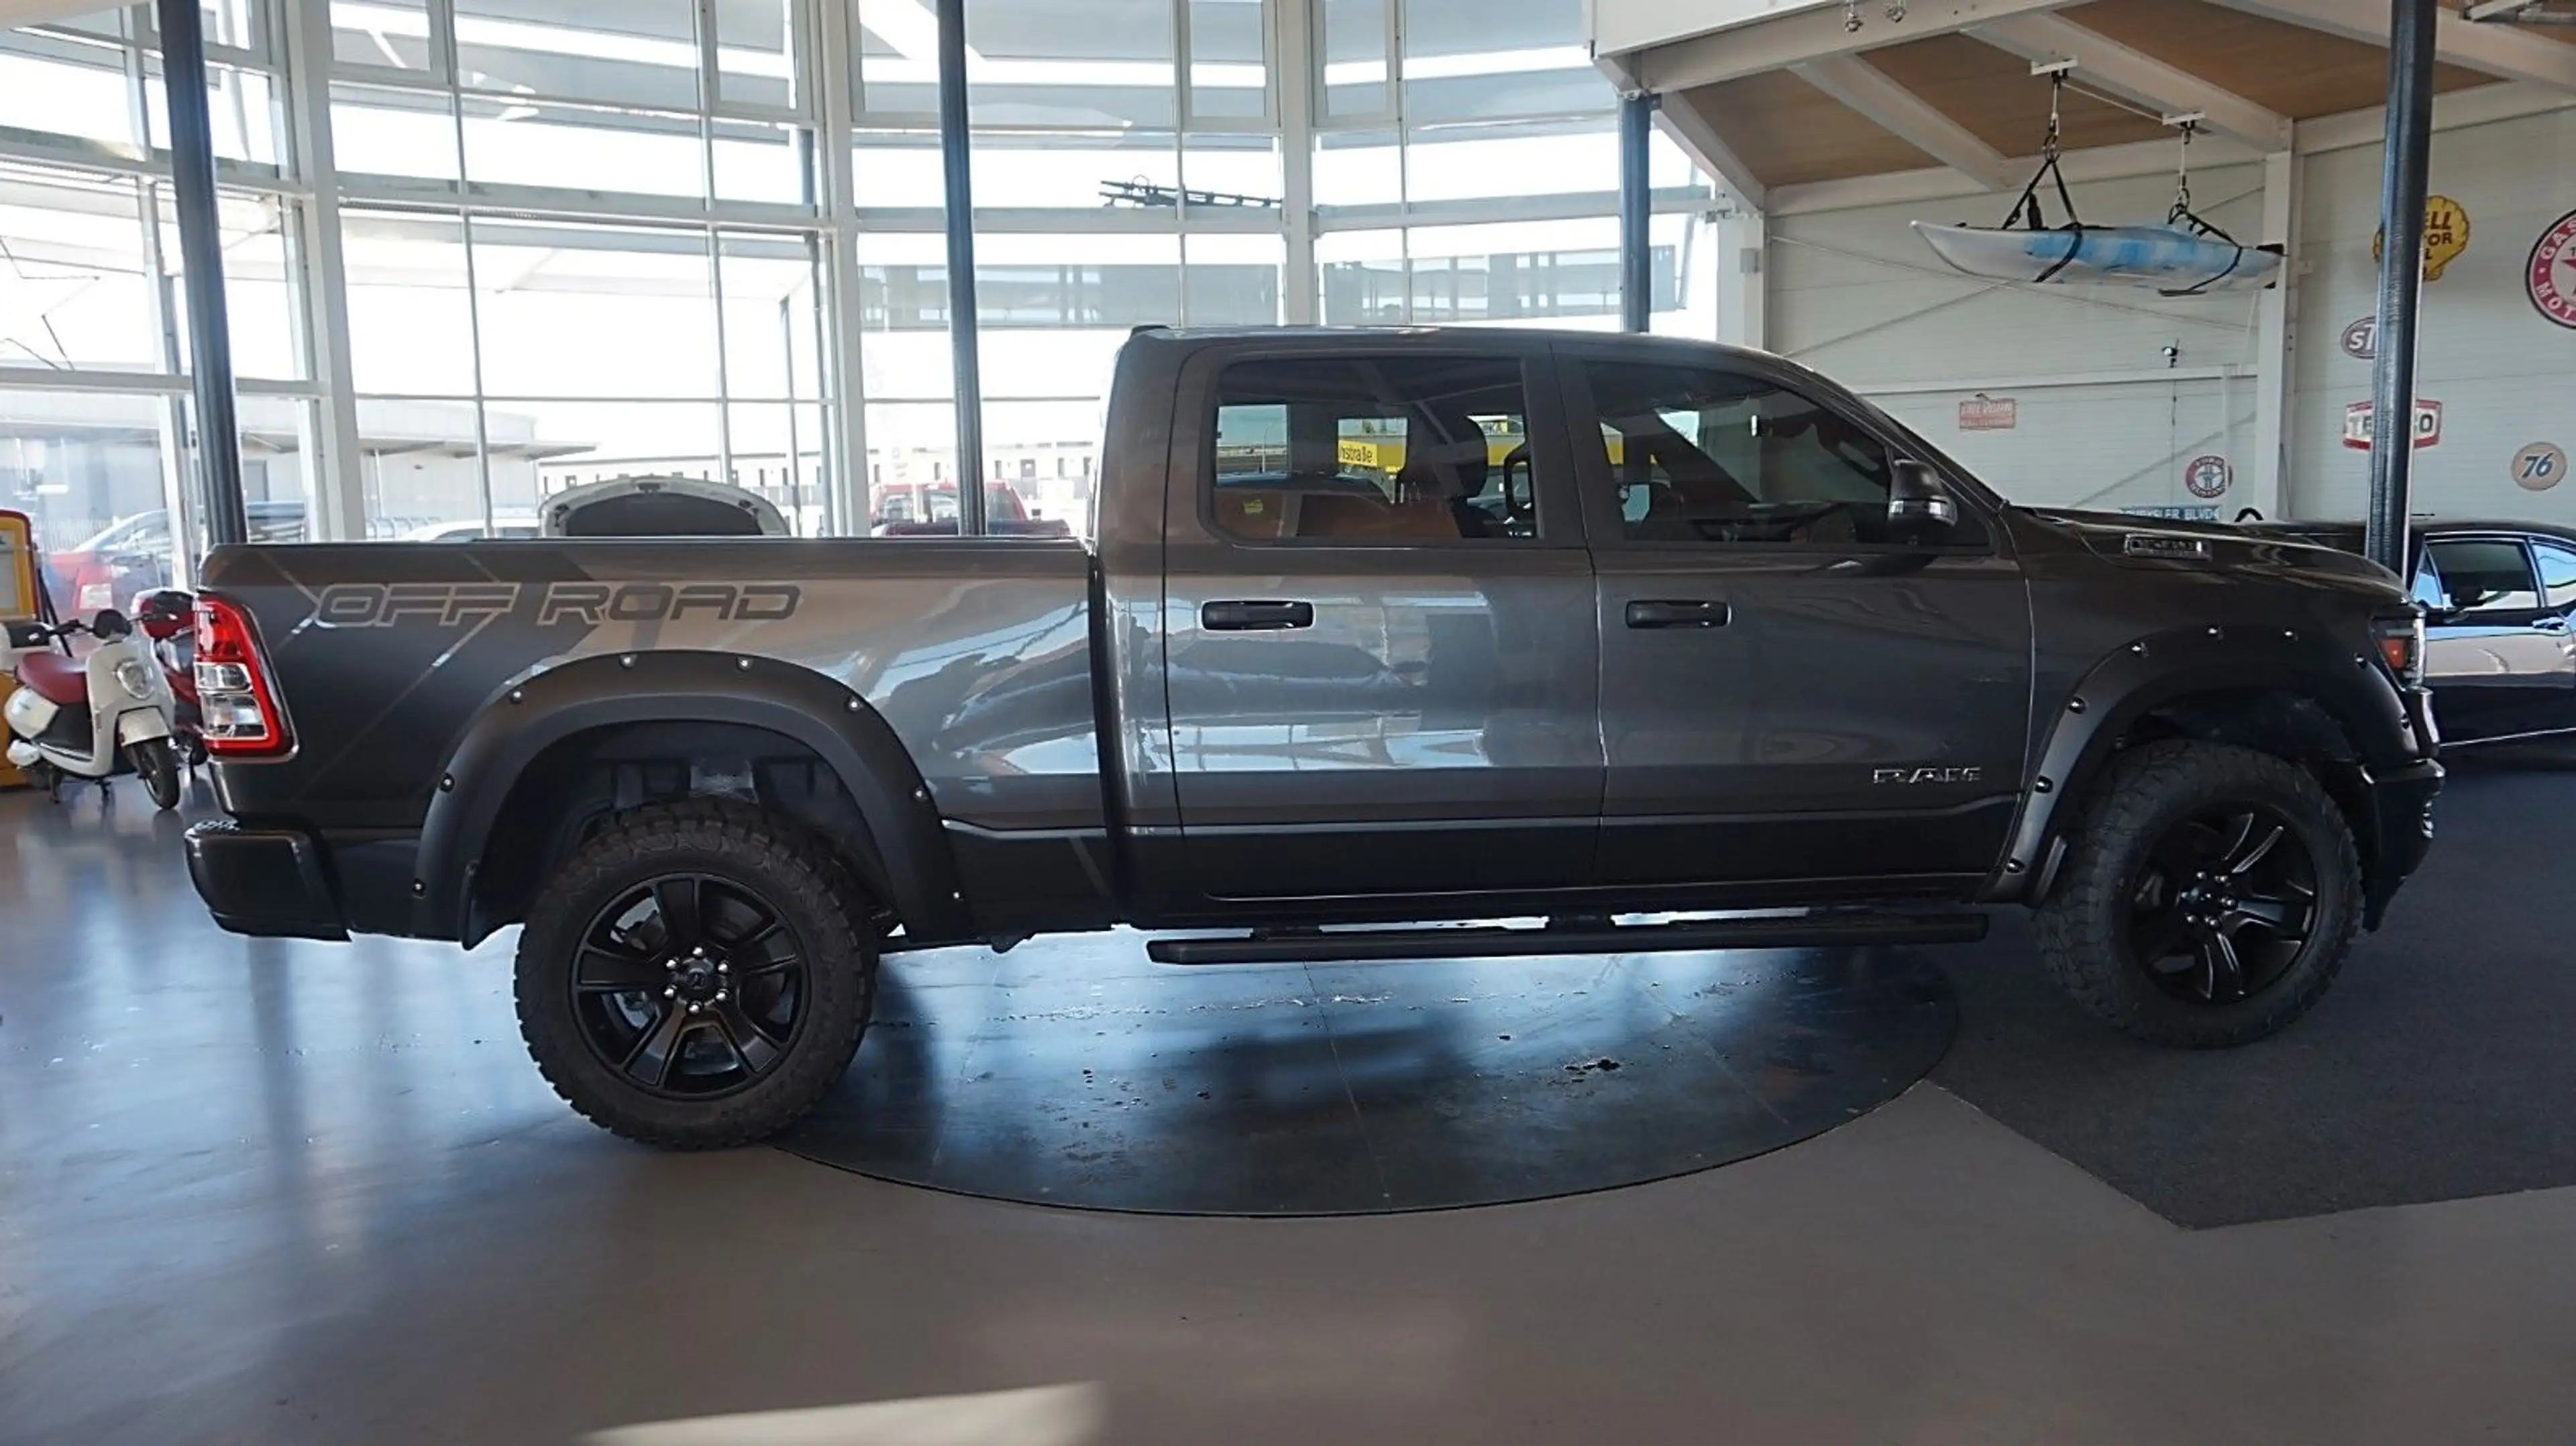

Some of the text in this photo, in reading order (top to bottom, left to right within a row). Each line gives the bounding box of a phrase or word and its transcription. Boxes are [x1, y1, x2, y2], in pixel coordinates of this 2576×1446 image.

[2349, 323, 2377, 351] ST
[2521, 452, 2554, 478] 76
[319, 580, 803, 628] OFF ROAD
[1873, 767, 1982, 784] RAM
